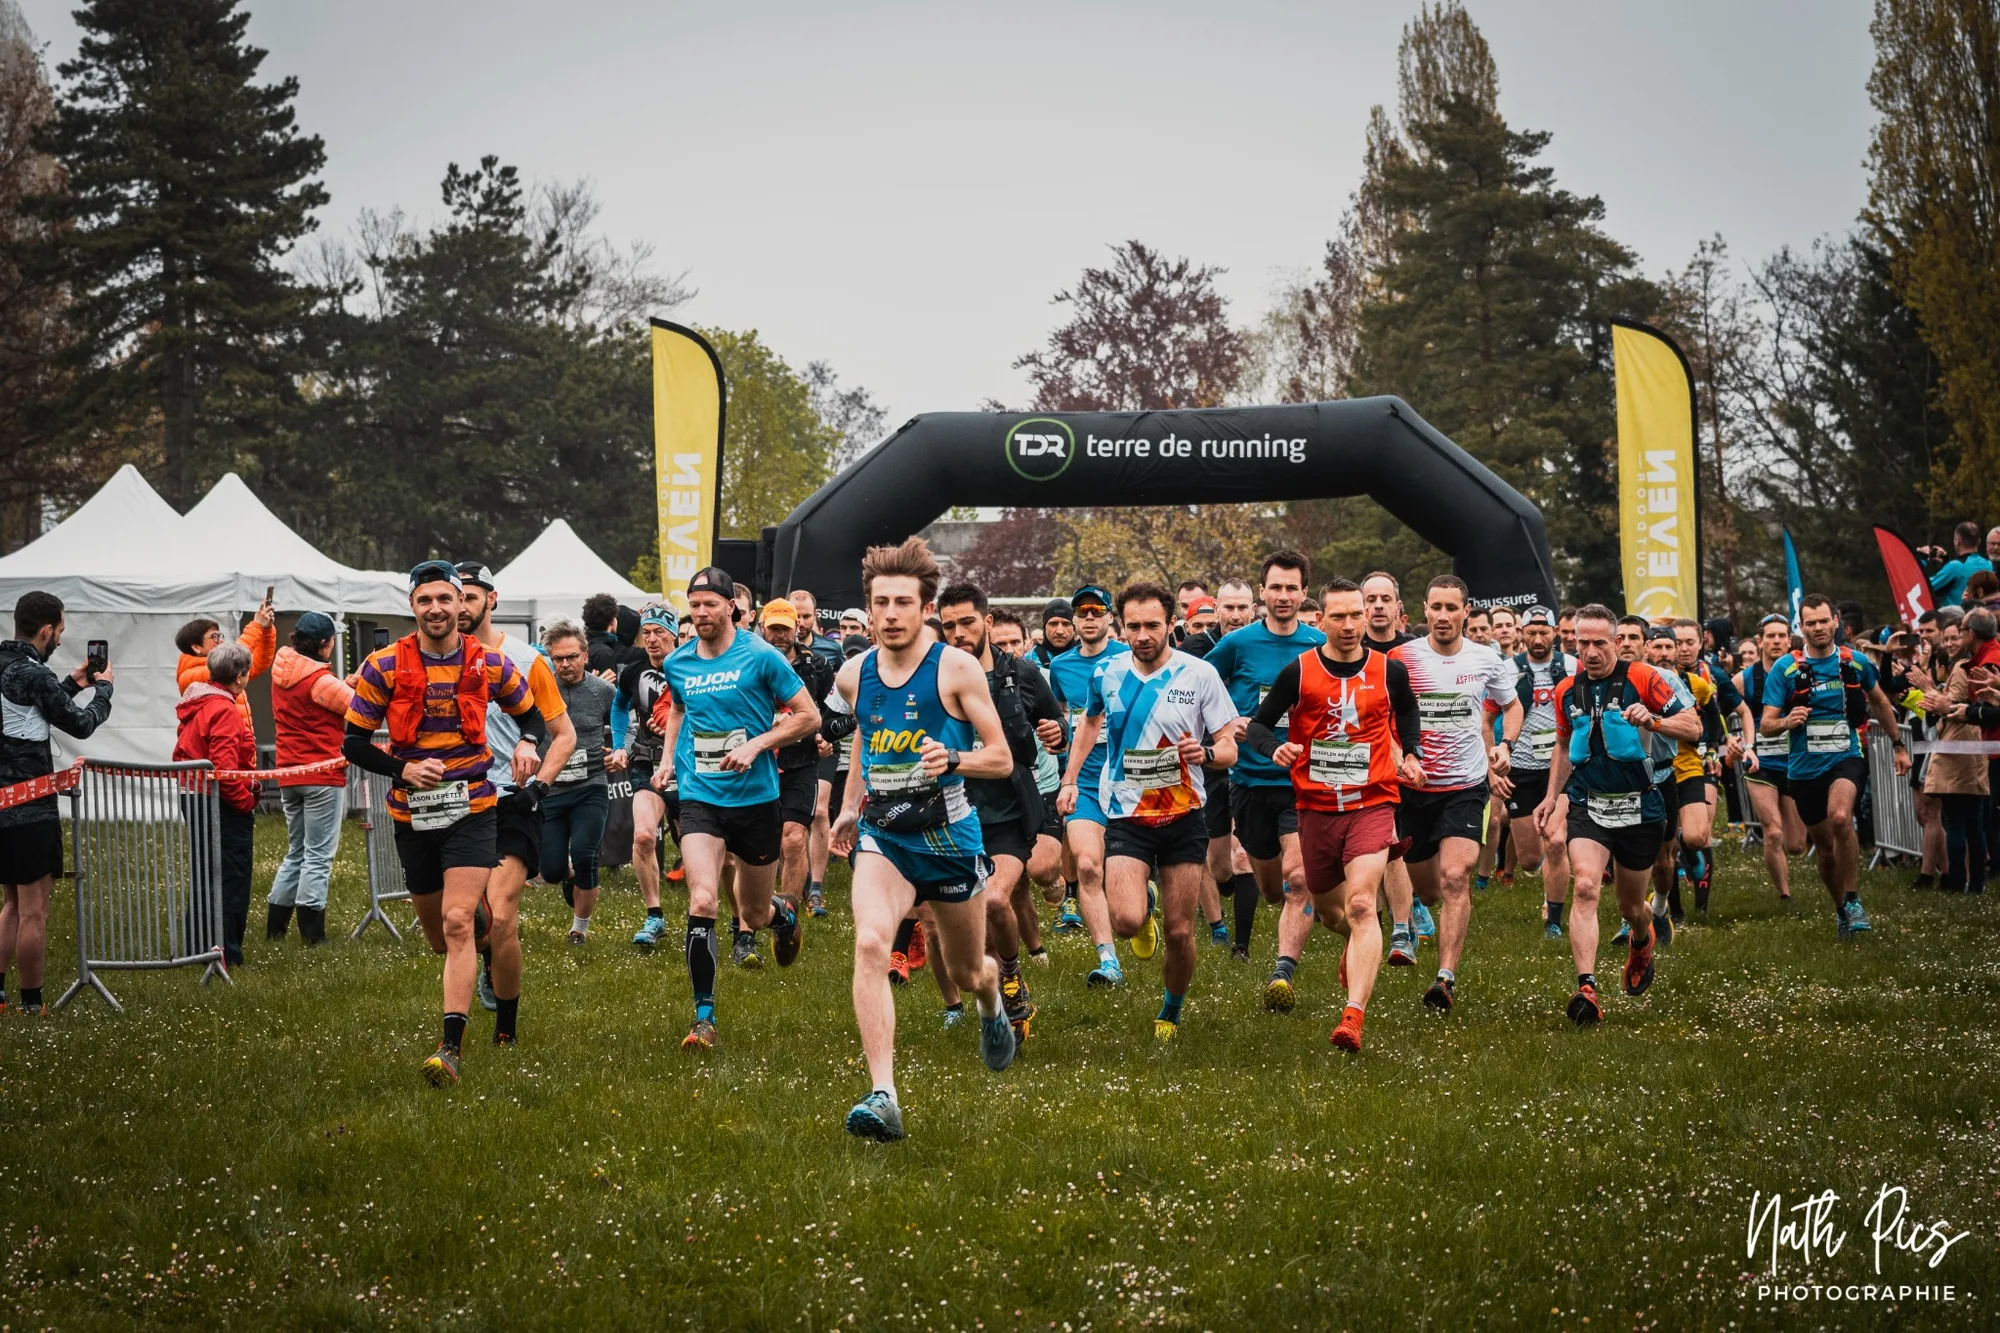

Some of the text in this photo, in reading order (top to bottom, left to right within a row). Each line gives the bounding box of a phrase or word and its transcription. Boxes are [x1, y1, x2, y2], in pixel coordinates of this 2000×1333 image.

[1014, 433, 1066, 458] TDR
[1086, 433, 1307, 464] terre de running
[684, 669, 741, 690] DIJON
[685, 683, 737, 697] Triathlon
[1167, 689, 1196, 698] ARNAY
[1167, 696, 1195, 705] LE DUC
[409, 792, 462, 803] JASON LEPETIT
[940, 882, 969, 894] FRANCE
